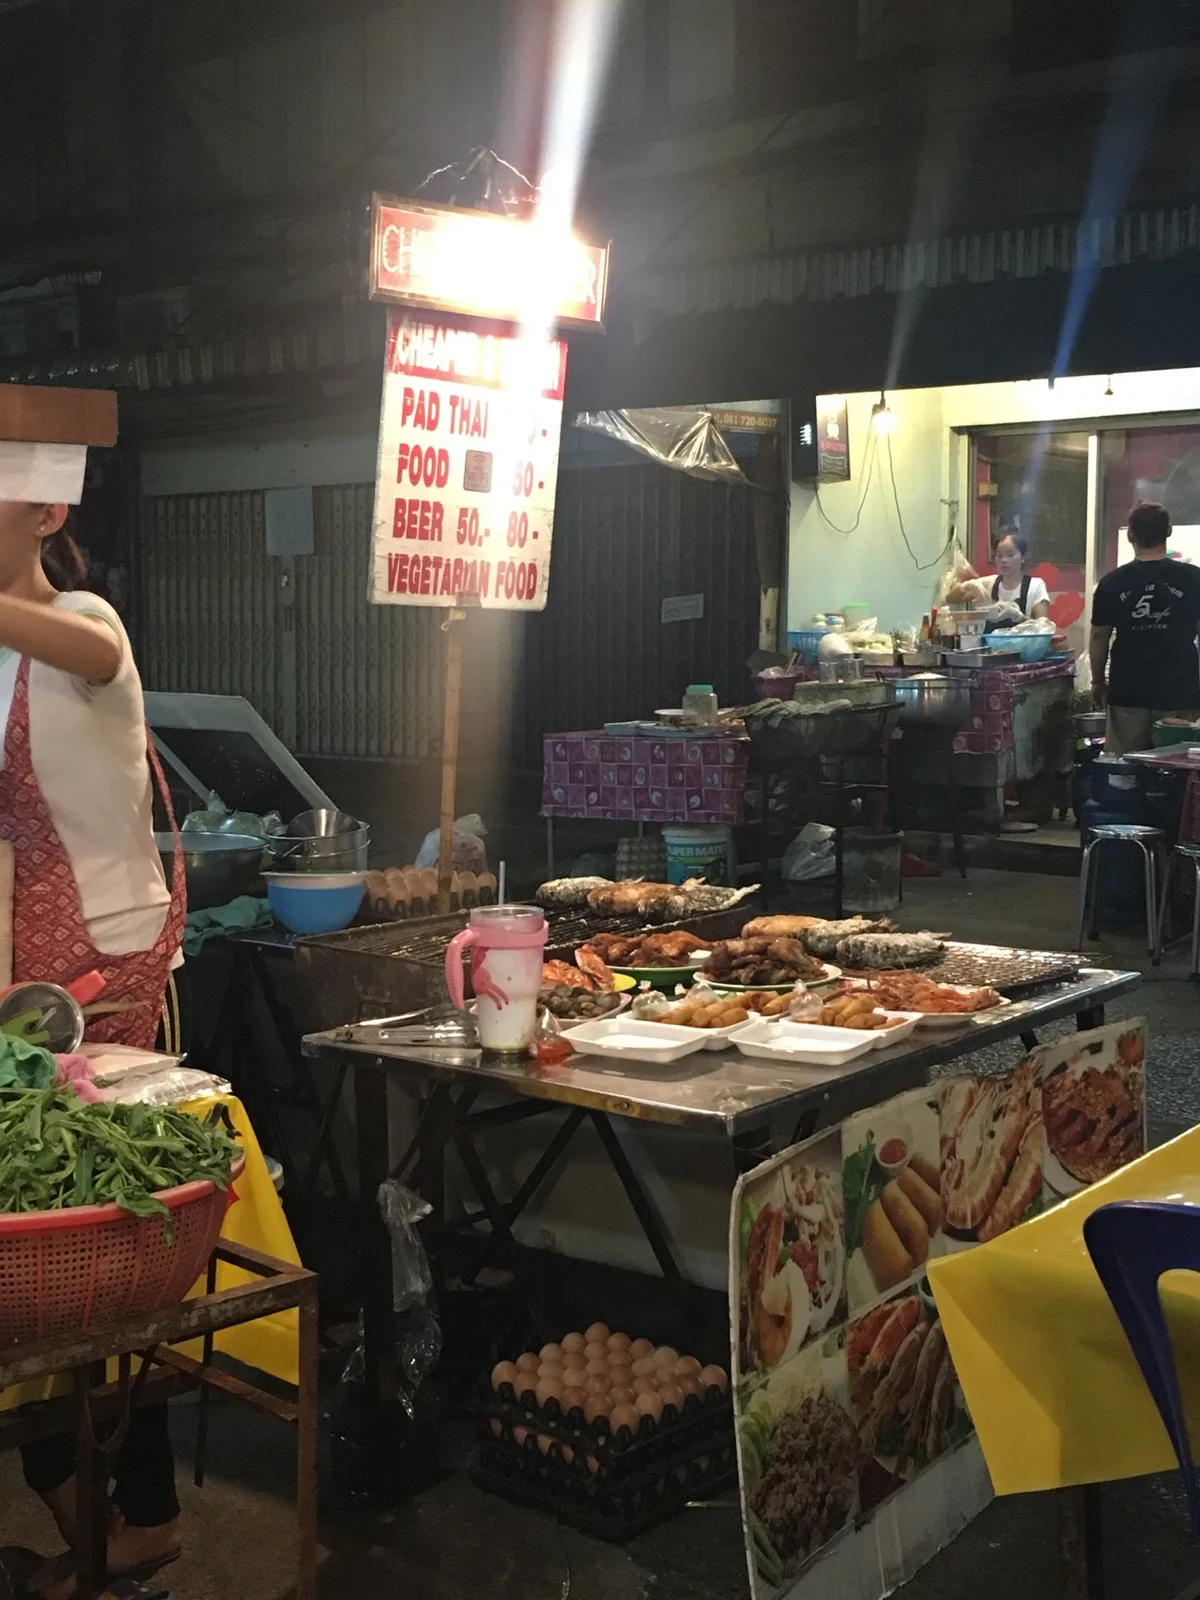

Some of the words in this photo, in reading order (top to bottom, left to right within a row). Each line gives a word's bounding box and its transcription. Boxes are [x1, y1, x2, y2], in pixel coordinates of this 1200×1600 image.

[401, 387, 440, 432] PAD
[449, 395, 489, 439] THAI
[397, 443, 450, 489] FOOD
[392, 497, 444, 542] BEER
[387, 552, 491, 598] VEGETARIAN
[495, 559, 538, 600] FOOD
